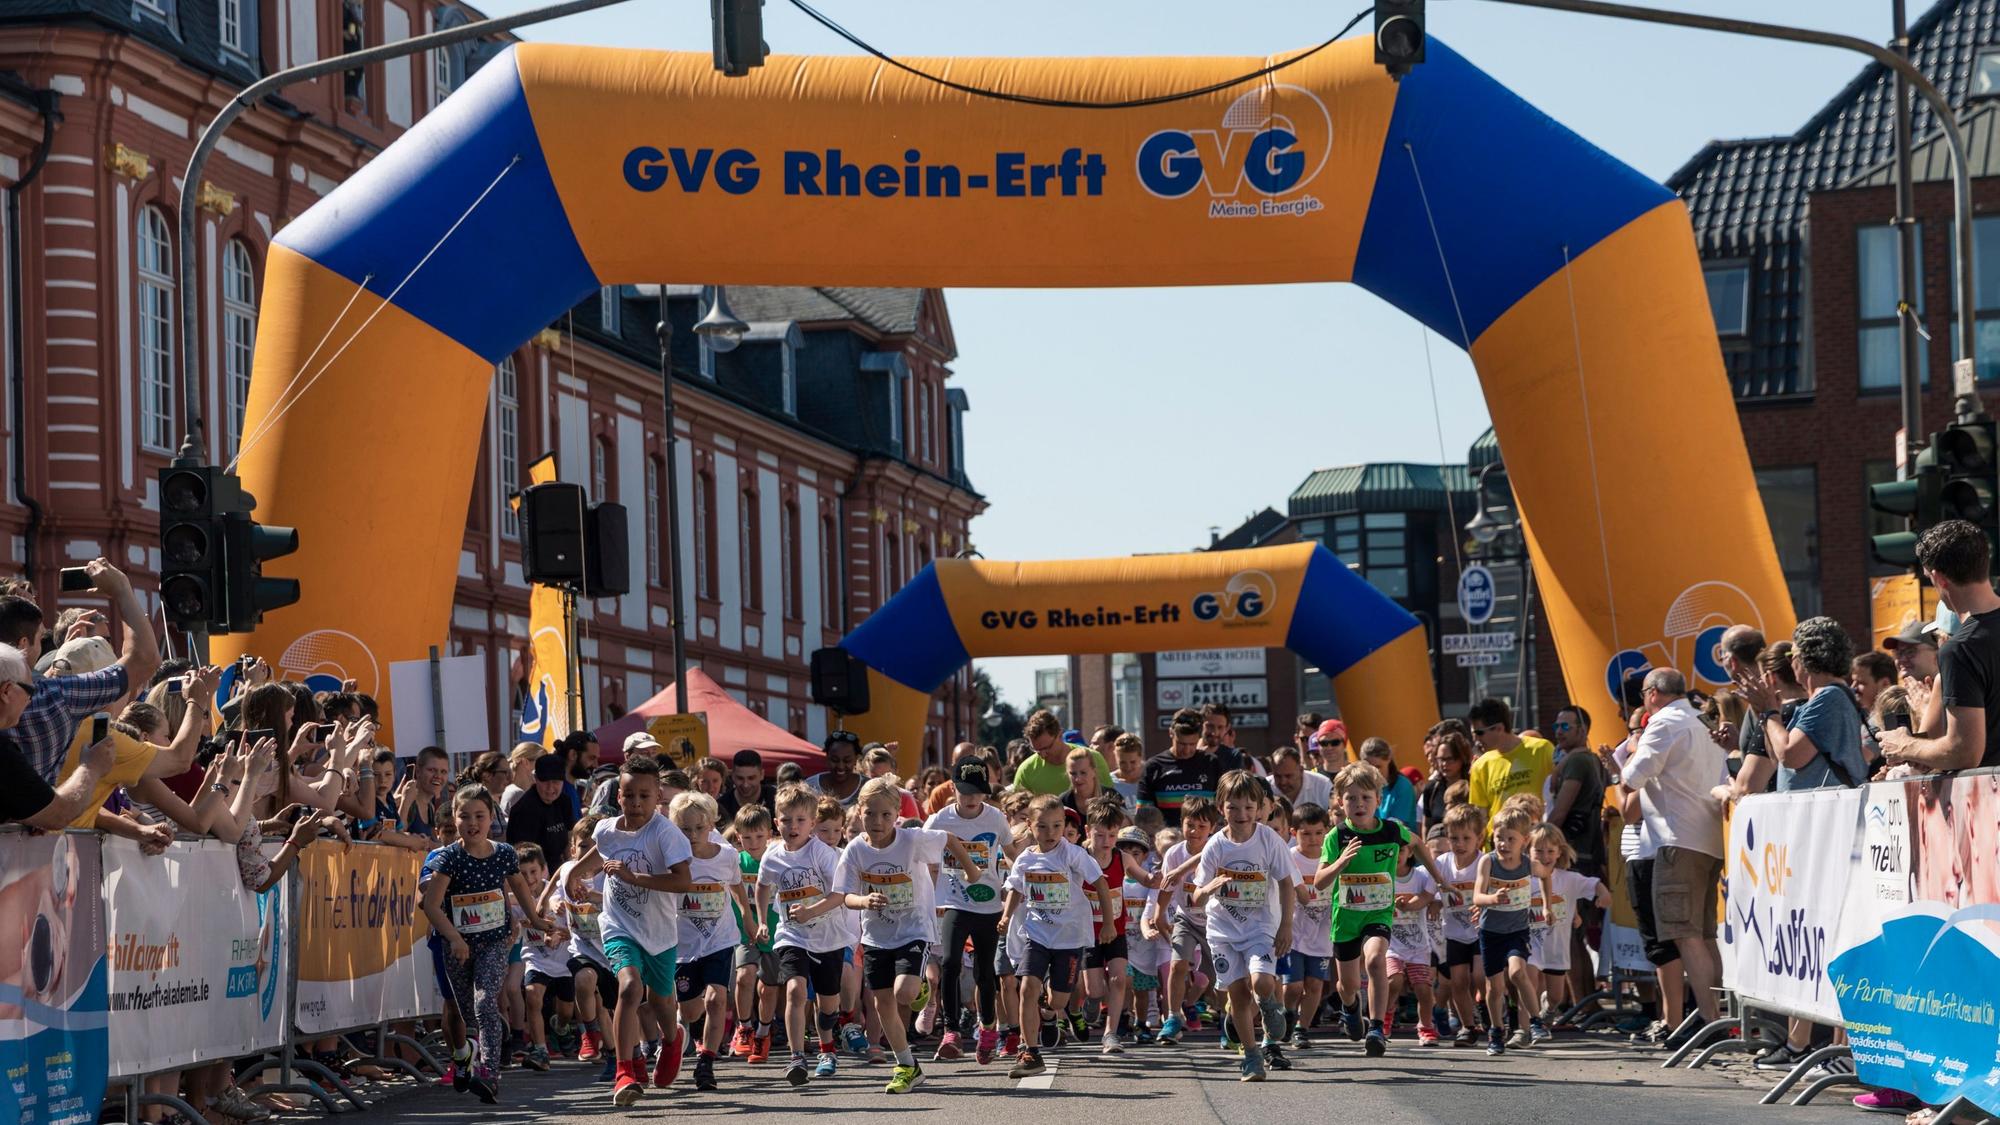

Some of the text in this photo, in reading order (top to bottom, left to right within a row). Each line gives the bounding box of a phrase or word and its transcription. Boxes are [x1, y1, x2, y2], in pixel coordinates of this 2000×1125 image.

[622, 145, 1107, 198] GVG Rhein-Erft
[1136, 127, 1306, 198] GVG
[1209, 200, 1257, 218] Meine
[980, 603, 1180, 629] GVG Rhein-Erft
[1192, 591, 1264, 622] GVG
[1444, 635, 1512, 651] BRAUHAUS
[1192, 682, 1233, 693] ABTEI
[1192, 693, 1259, 704] PASSAGE
[1165, 783, 1203, 791] MACH3
[1835, 973, 1853, 999] Ihr
